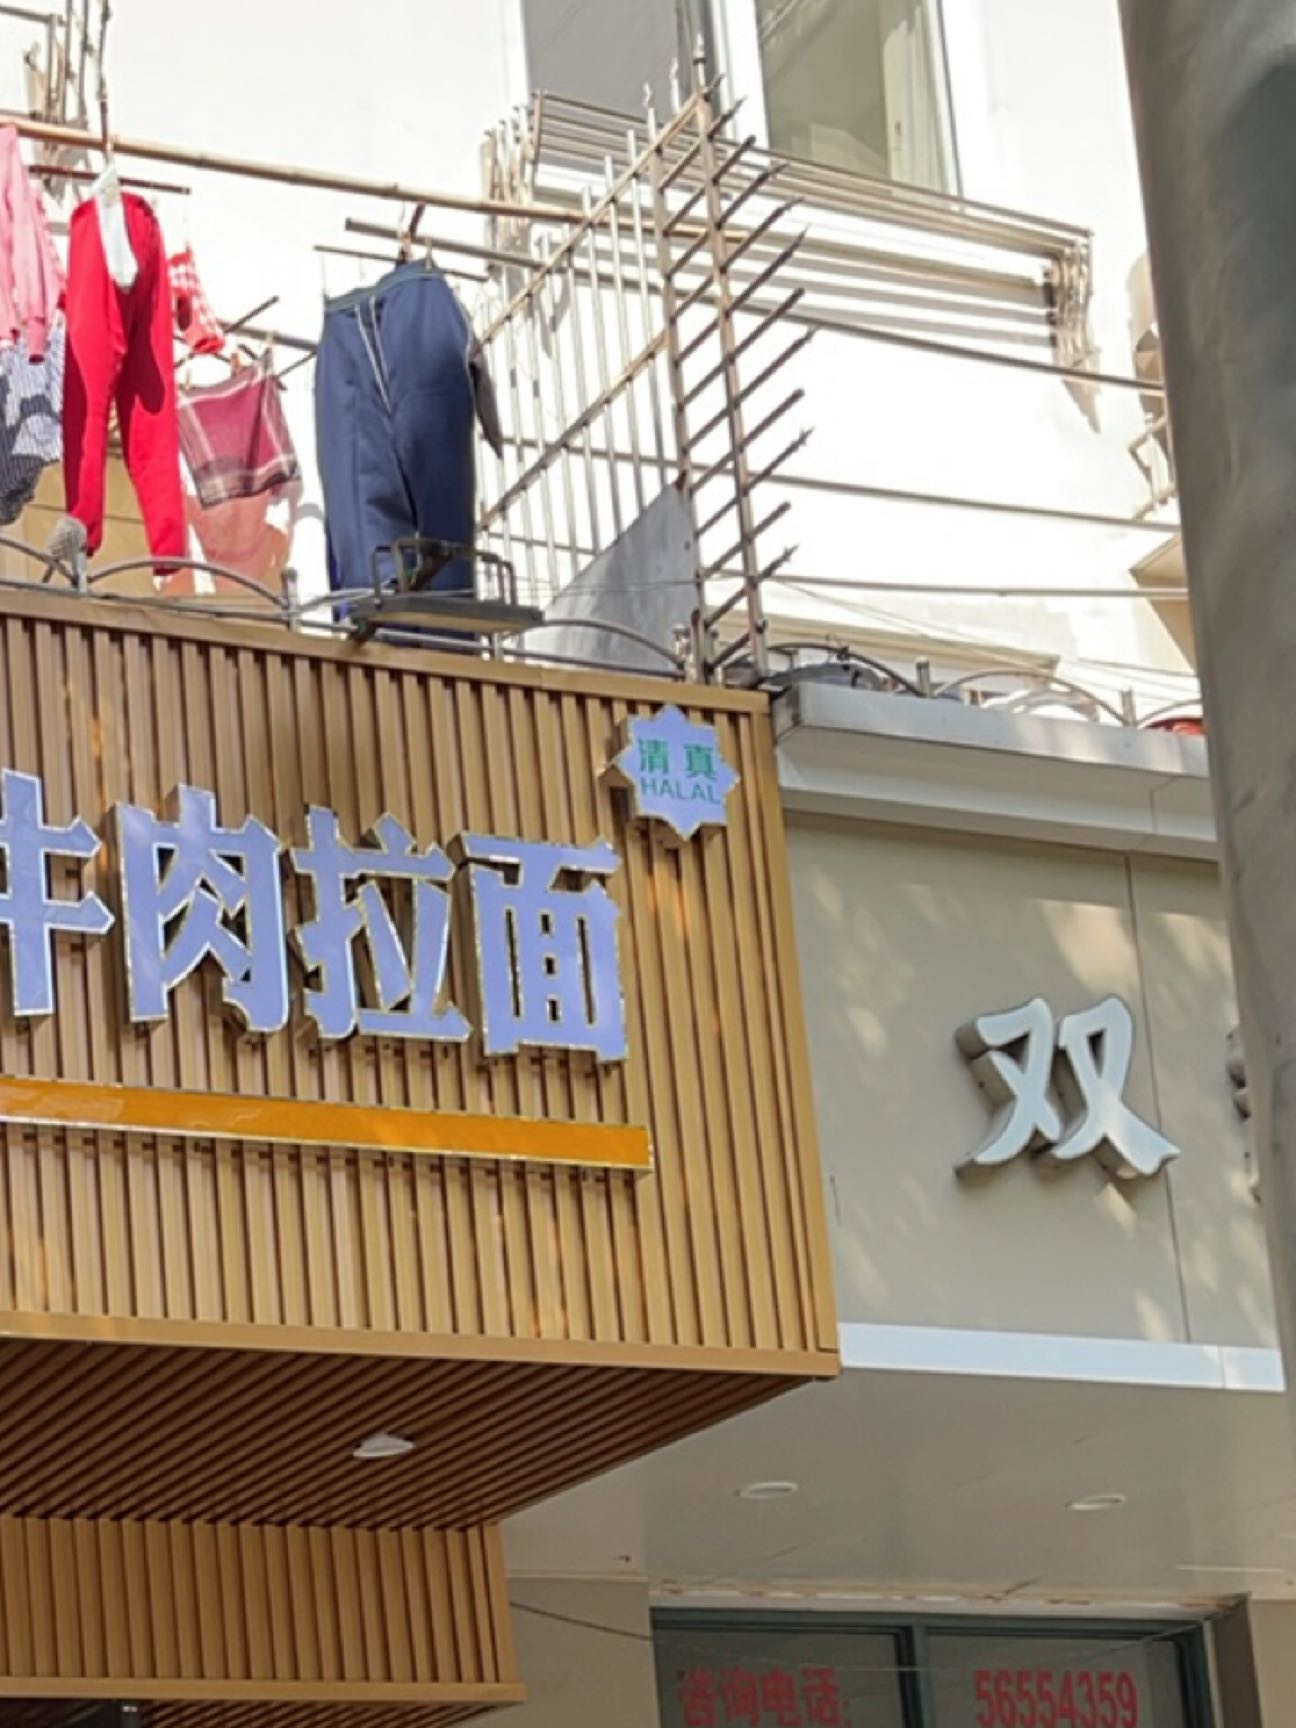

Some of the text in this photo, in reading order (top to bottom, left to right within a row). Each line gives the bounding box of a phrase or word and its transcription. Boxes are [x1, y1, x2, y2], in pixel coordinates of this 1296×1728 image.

[638, 738, 716, 780] 清真
[640, 777, 721, 805] HALAL
[970, 996, 1182, 1176] 双
